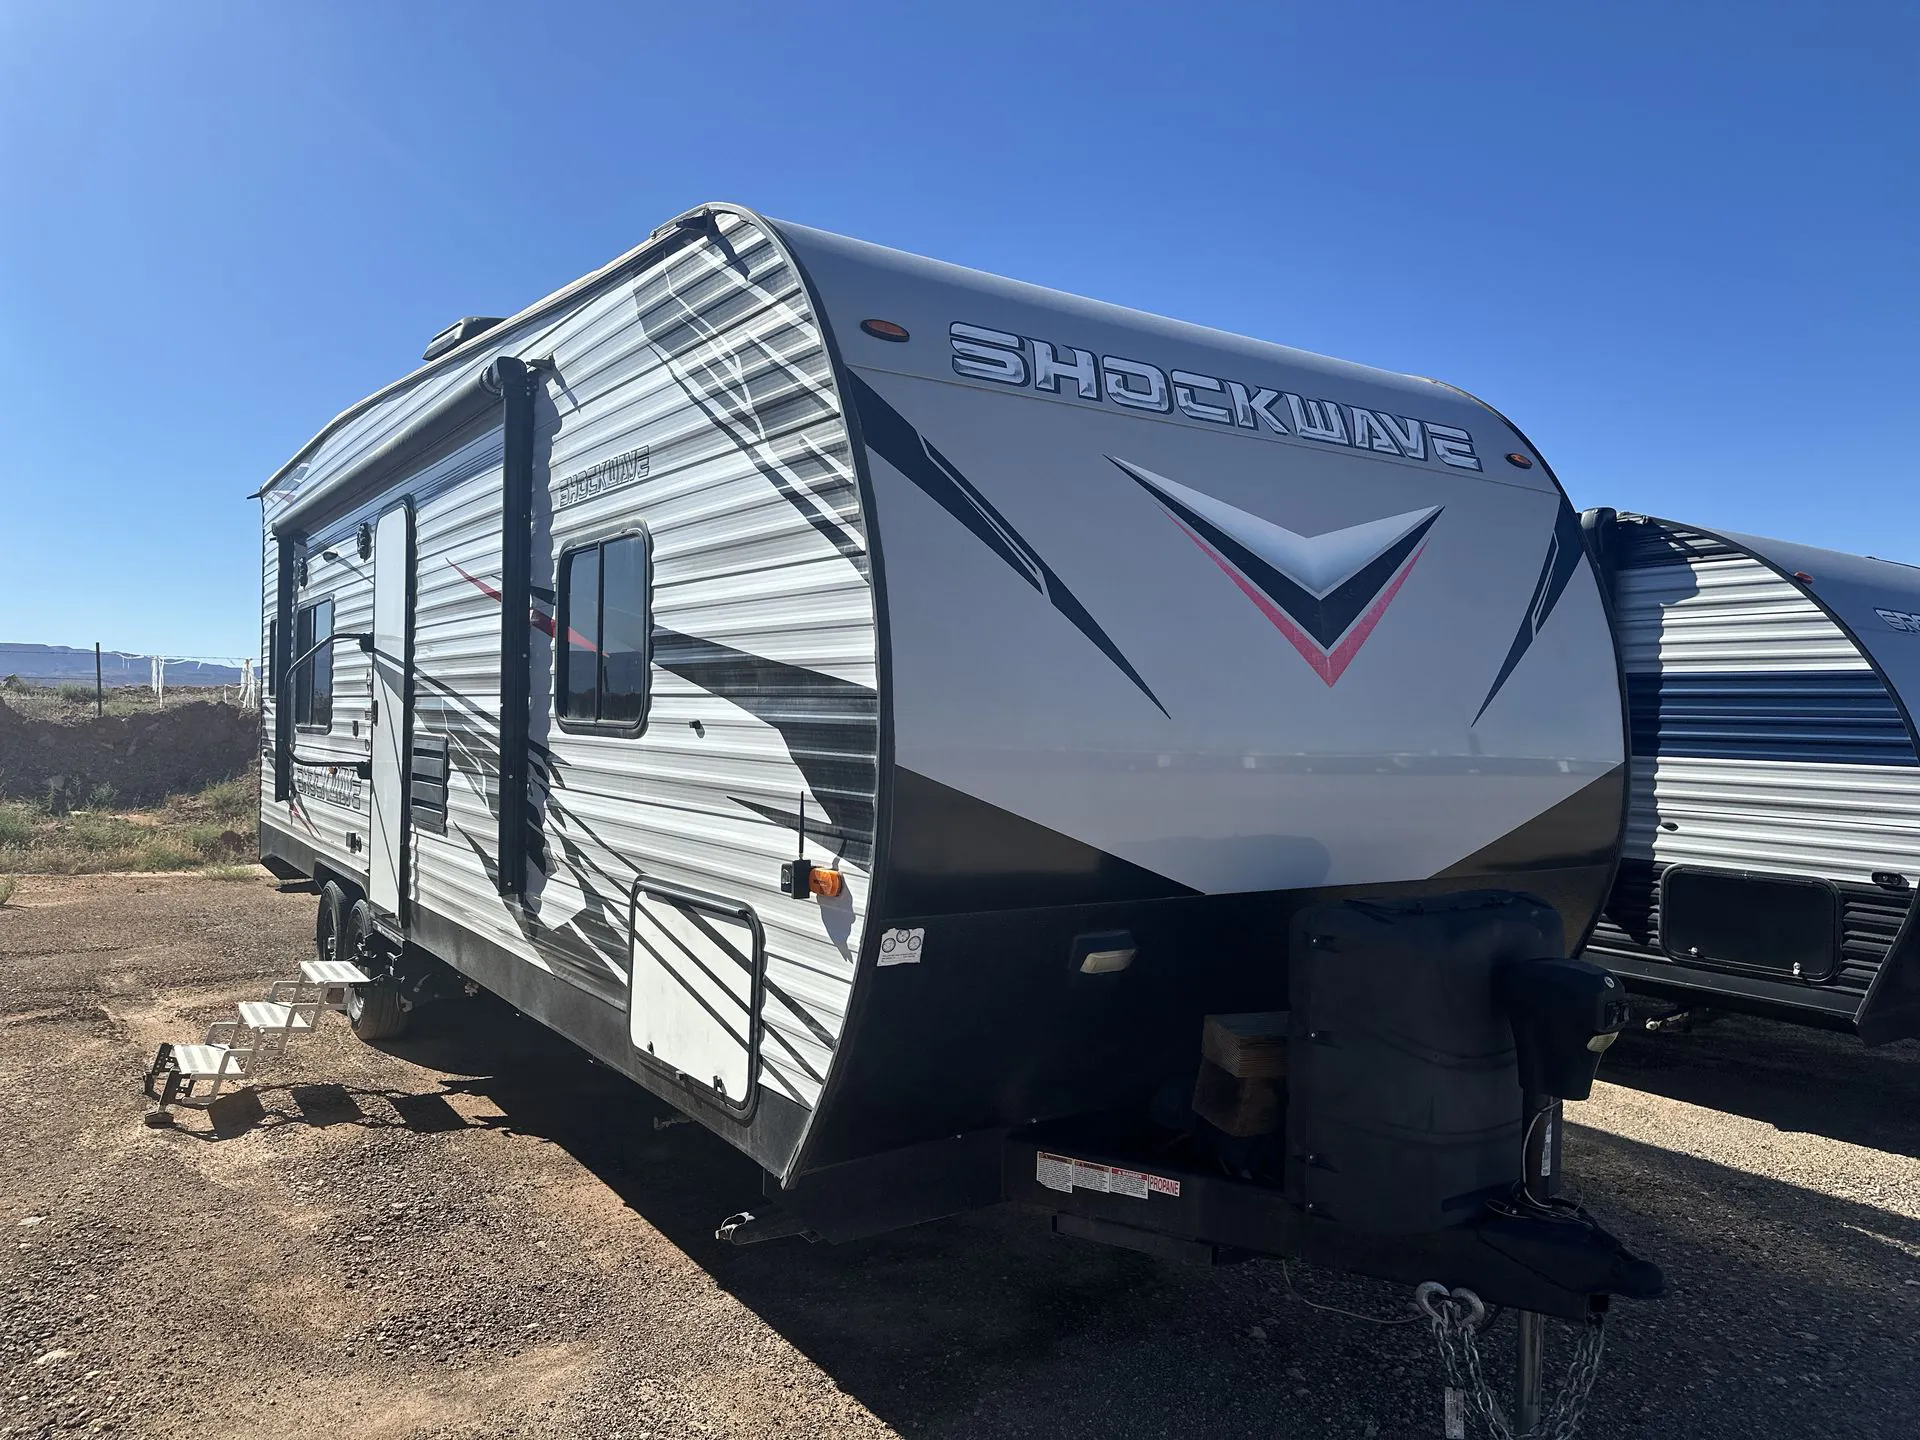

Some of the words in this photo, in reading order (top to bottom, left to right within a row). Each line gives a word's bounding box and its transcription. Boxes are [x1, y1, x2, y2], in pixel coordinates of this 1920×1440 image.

[949, 321, 1483, 473] SHOCKWAVE
[559, 445, 650, 507] SHOCKWAVE
[1151, 1177, 1179, 1195] PROPANE
